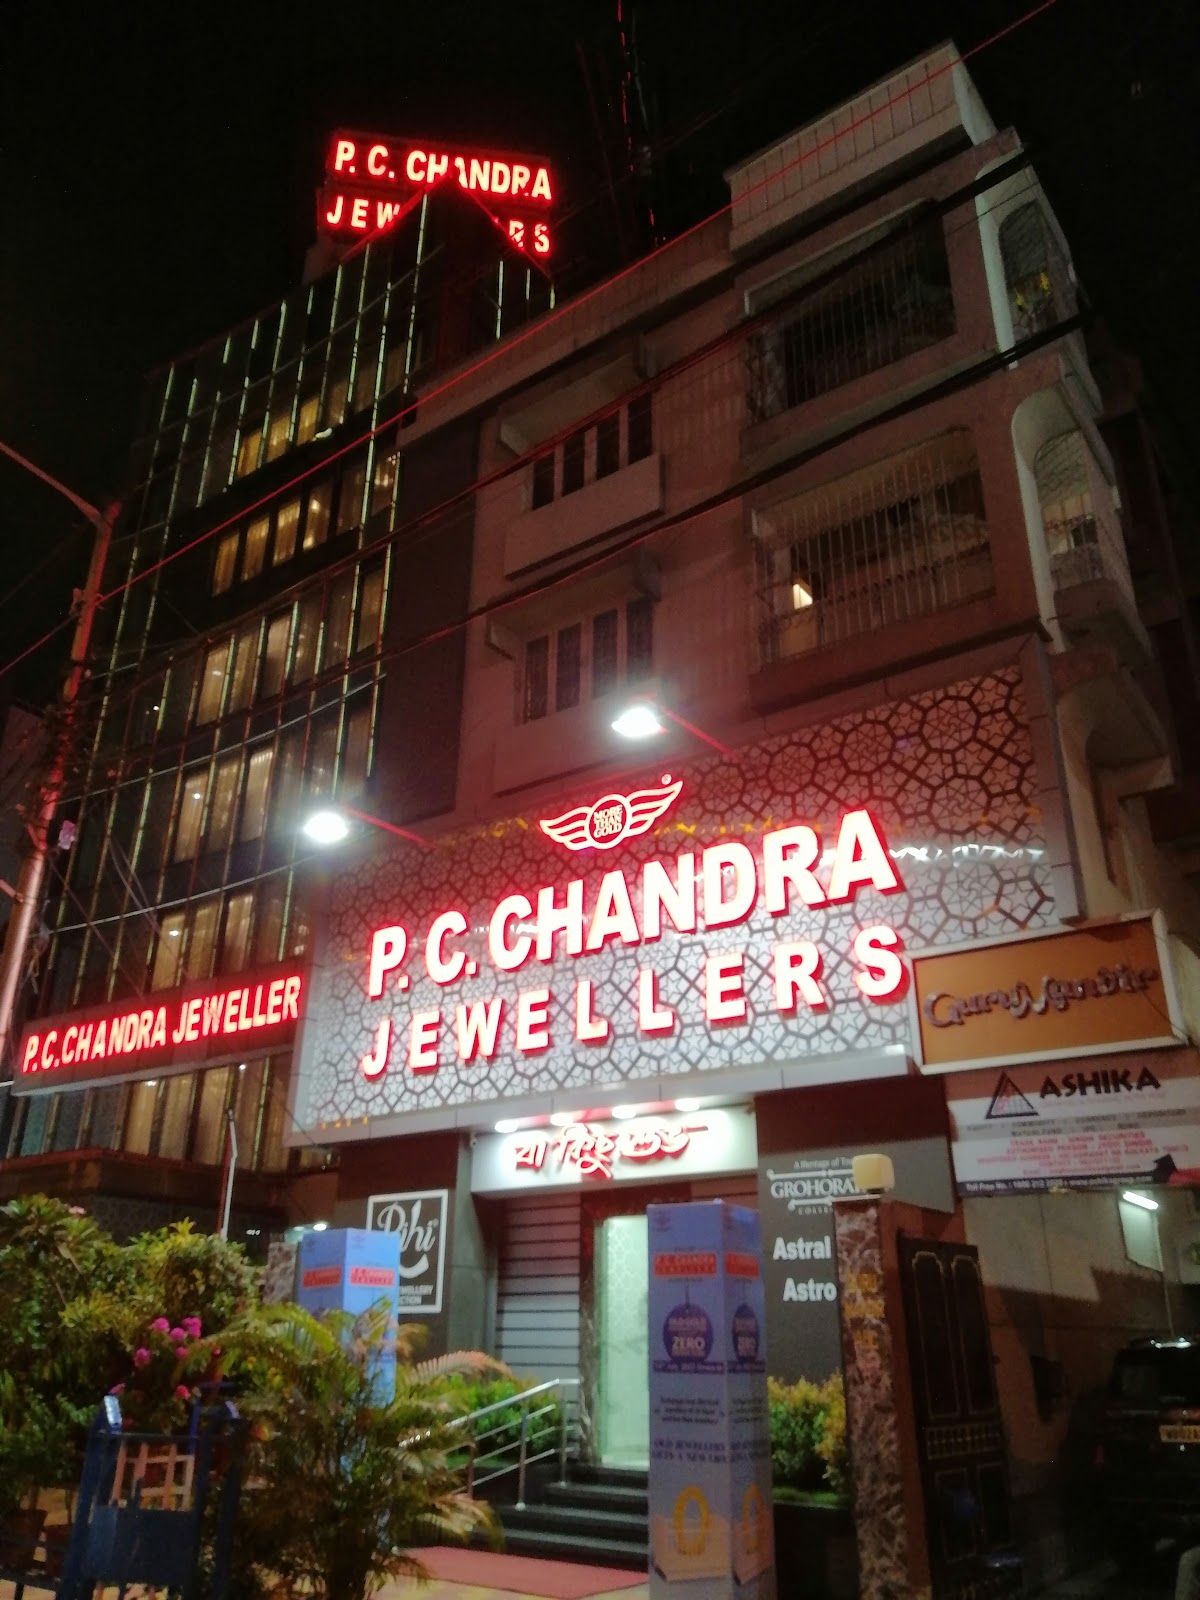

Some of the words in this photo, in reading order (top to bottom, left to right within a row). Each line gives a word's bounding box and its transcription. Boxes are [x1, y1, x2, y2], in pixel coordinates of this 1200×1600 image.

[594, 805, 623, 820] MORE
[594, 814, 623, 830] THAN
[594, 823, 623, 838] GOLD
[487, 808, 903, 972] CHANDRA
[172, 975, 302, 1044] JEWELLER
[361, 924, 909, 1080] JEWELLERS
[1039, 1066, 1161, 1099] ASHIKA
[773, 1235, 832, 1260] Astral
[782, 1277, 838, 1302] Astro
